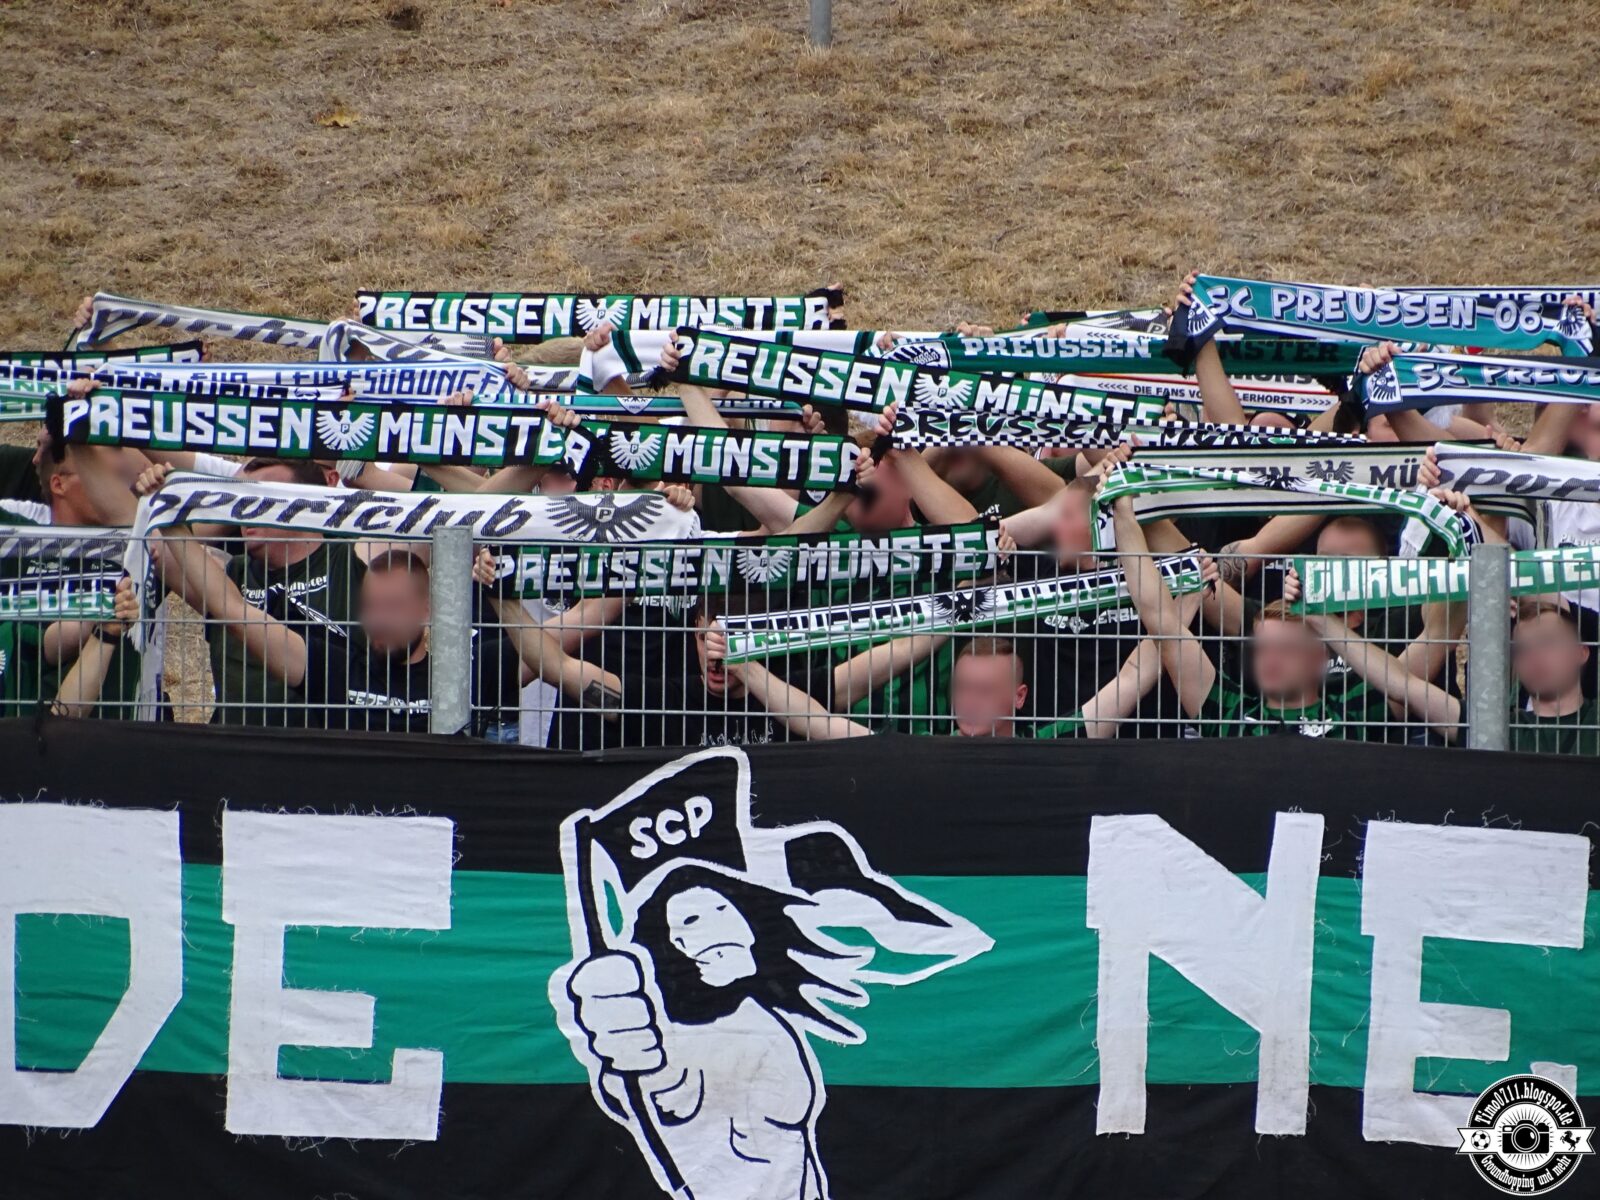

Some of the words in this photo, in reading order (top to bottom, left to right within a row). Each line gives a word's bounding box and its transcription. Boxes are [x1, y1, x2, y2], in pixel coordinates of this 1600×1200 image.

[358, 296, 577, 335] PREUSSEN
[629, 296, 832, 332] MÜNSTER
[1206, 285, 1259, 321] SC
[1271, 287, 1478, 331] PREUSSEN
[1495, 299, 1544, 336] 06
[674, 336, 913, 405] PREUSSEN
[961, 338, 1152, 358] PREUSSEN
[1134, 385, 1152, 395] DIE
[1156, 387, 1185, 398] FANS
[1414, 363, 1470, 390] SC
[63, 395, 312, 450] PREUSSEN
[378, 409, 591, 474] MÜNSTER
[493, 545, 732, 593] PREUSSEN
[629, 795, 713, 860] SCP
